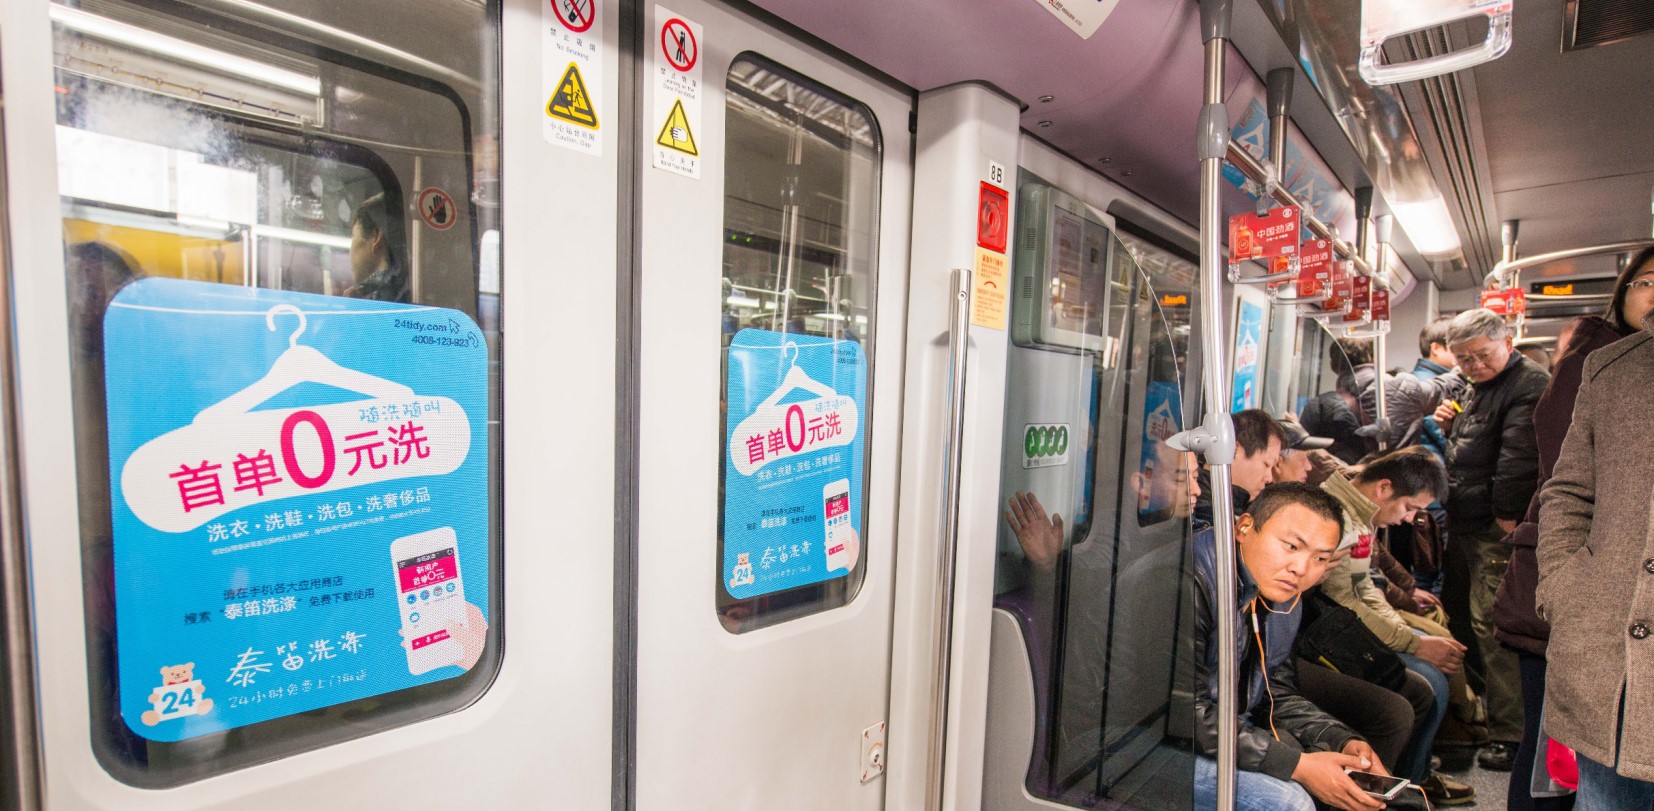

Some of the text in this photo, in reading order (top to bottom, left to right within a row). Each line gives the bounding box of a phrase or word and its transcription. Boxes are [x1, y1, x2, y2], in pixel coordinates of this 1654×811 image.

[990, 165, 1003, 184] 8B
[1256, 221, 1295, 239] 中国劲酒
[394, 318, 447, 332] 24tidy.com
[359, 399, 441, 424] 随洗随叫
[746, 404, 842, 465] 首单0元洗
[169, 410, 431, 513] 首单0元洗
[736, 567, 749, 583] 24
[223, 575, 343, 601] 请在手机各大应用商店
[226, 630, 367, 688] 泰笛洗涤
[161, 685, 195, 714] 24
